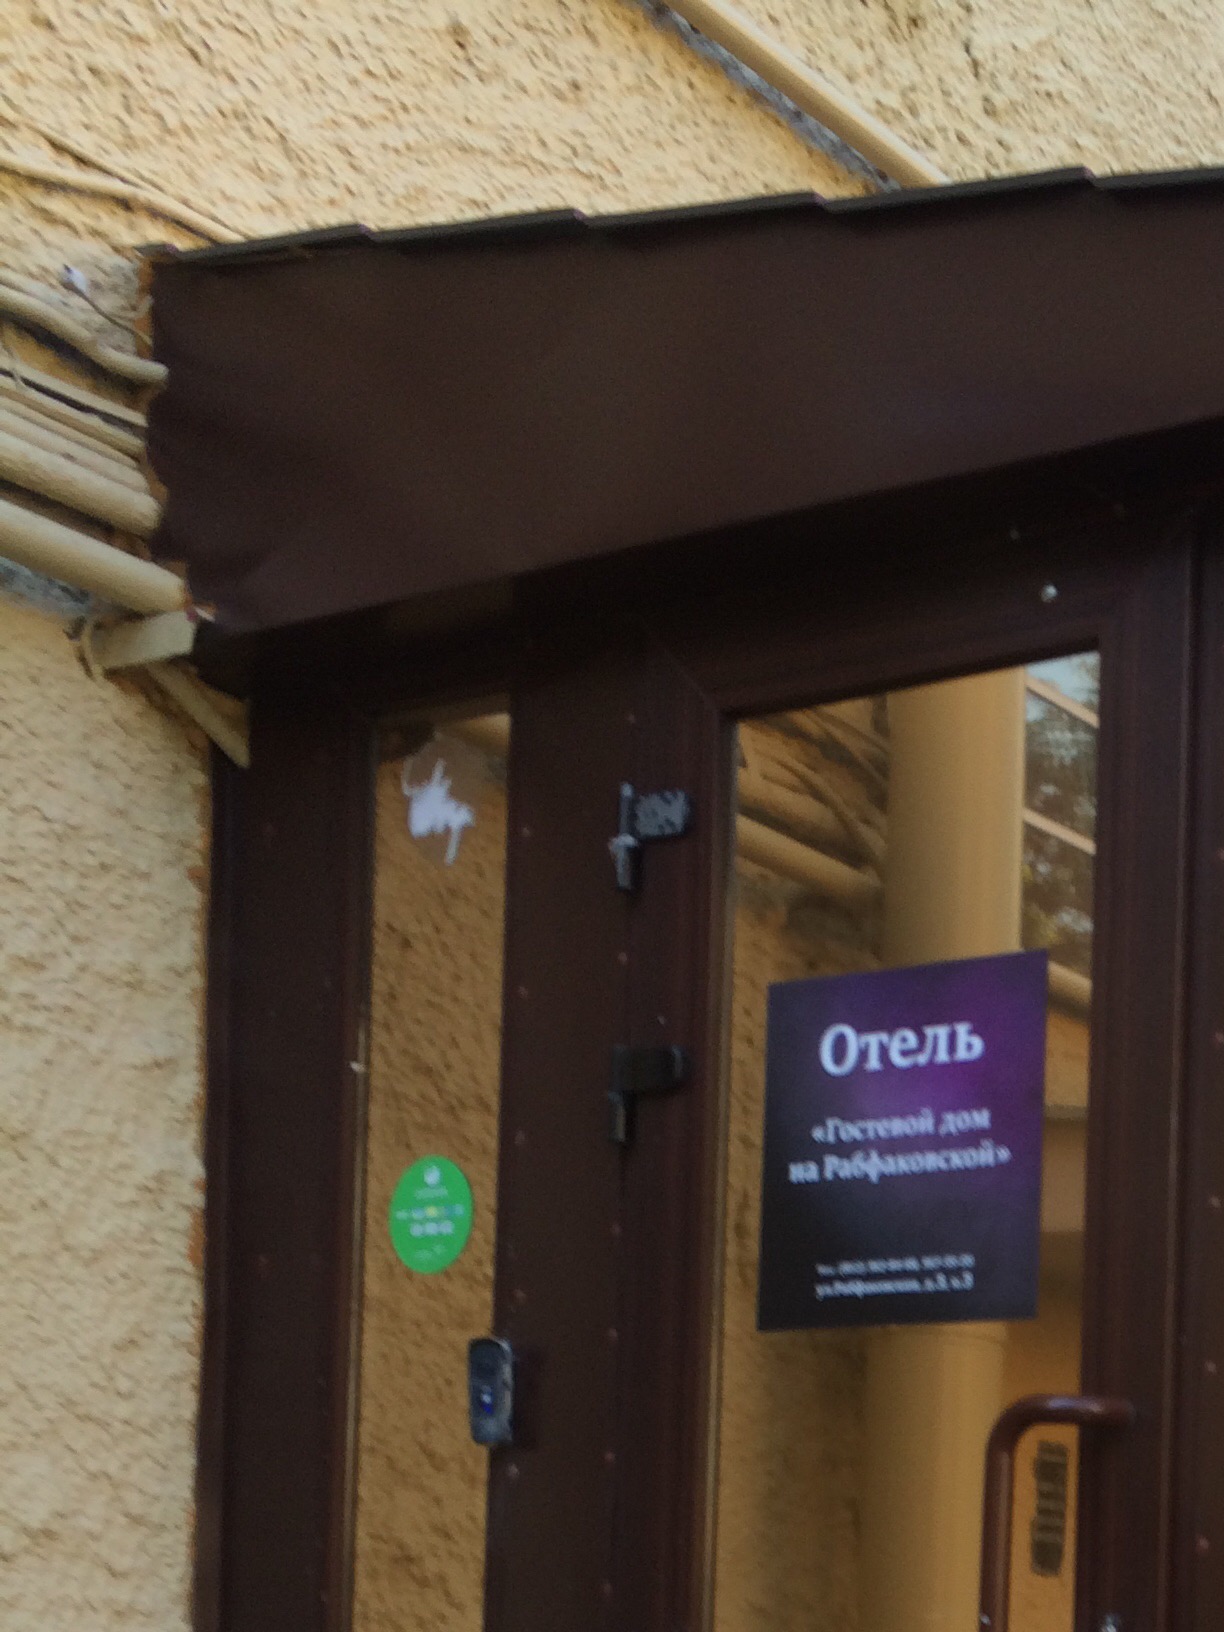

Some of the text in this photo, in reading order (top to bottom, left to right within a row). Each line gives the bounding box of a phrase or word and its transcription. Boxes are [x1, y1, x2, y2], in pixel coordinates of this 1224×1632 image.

[819, 1022, 985, 1077] Отель
[938, 1108, 992, 1137] дом
[789, 1160, 820, 1184] на
